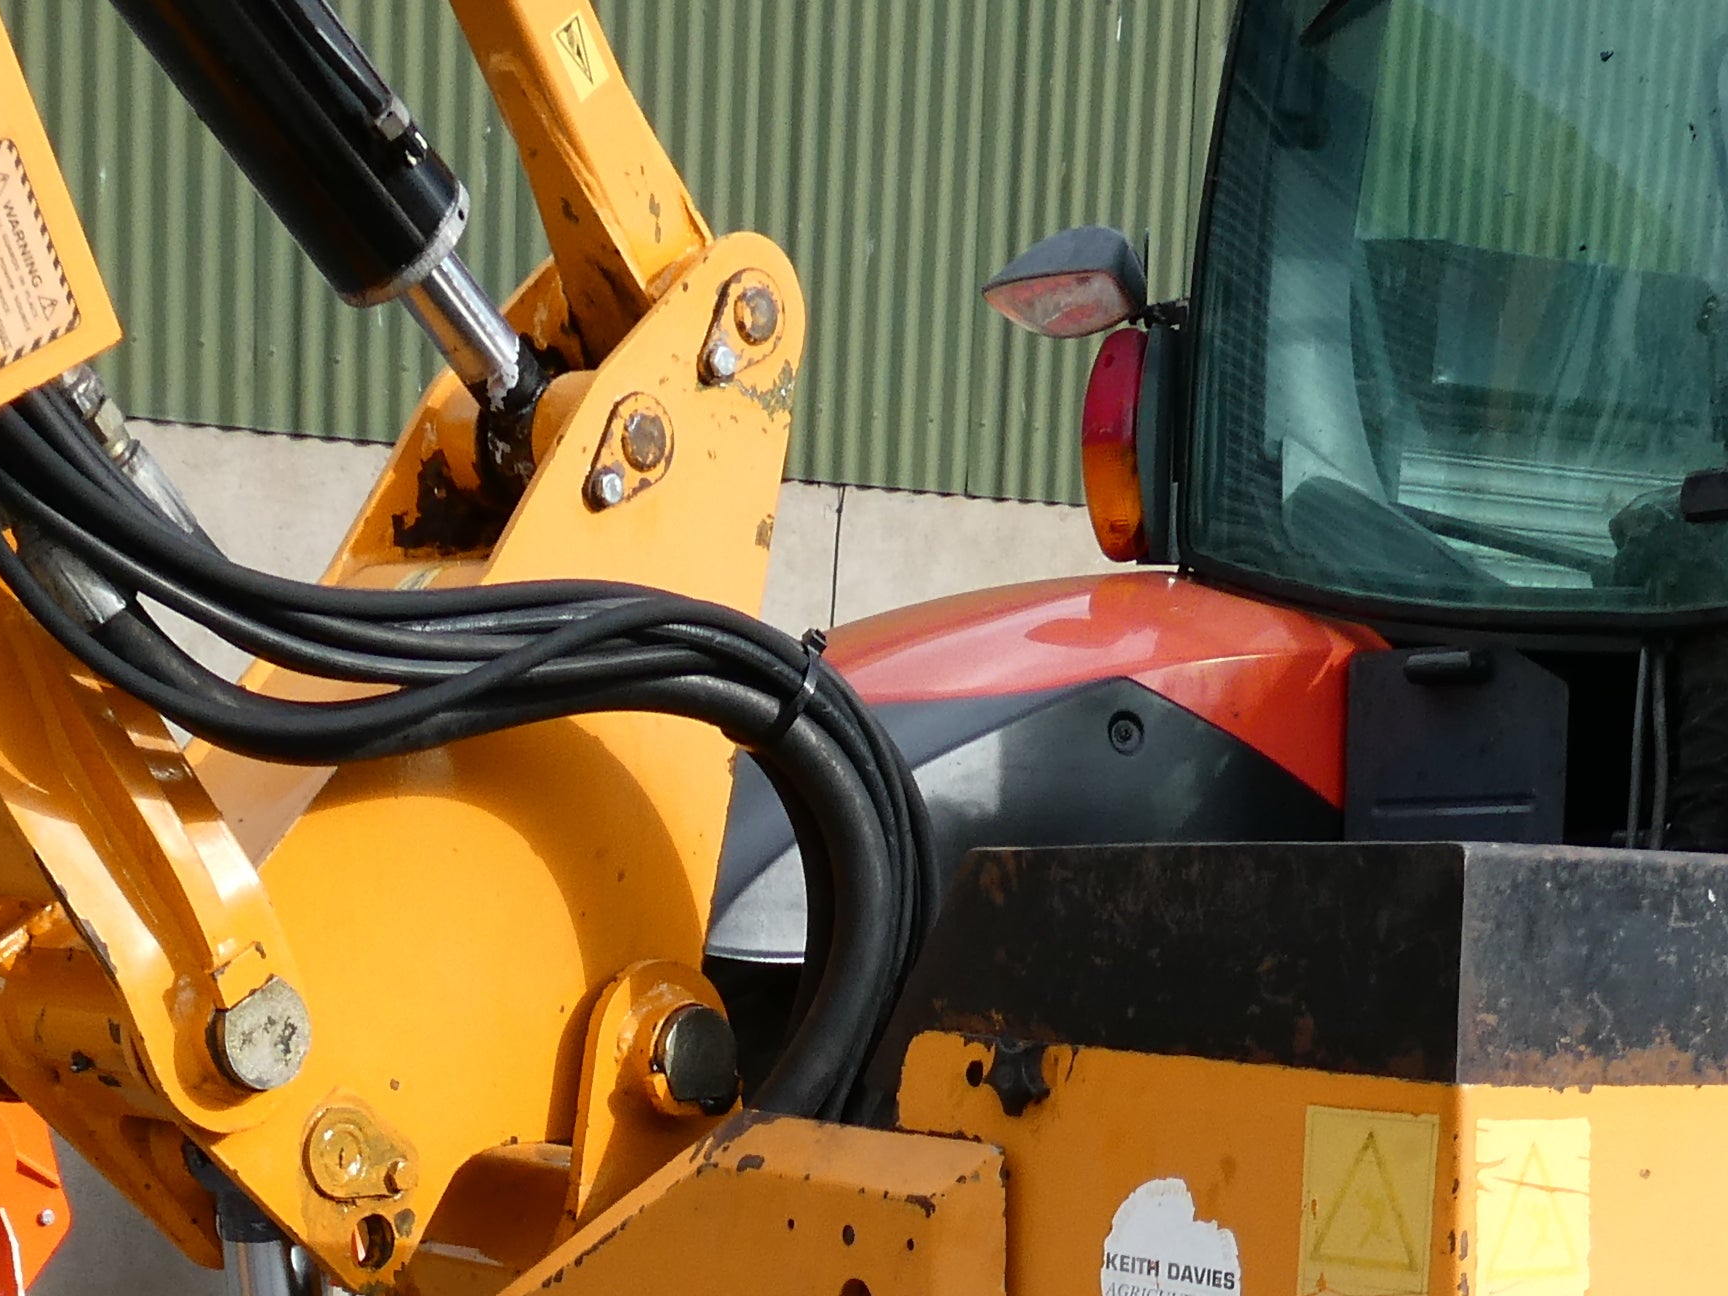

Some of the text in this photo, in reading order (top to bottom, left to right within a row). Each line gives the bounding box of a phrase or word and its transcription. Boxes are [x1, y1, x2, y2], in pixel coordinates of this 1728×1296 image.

[0, 199, 44, 290] WARNING
[1105, 1251, 1236, 1290] KEITH DAVIES
